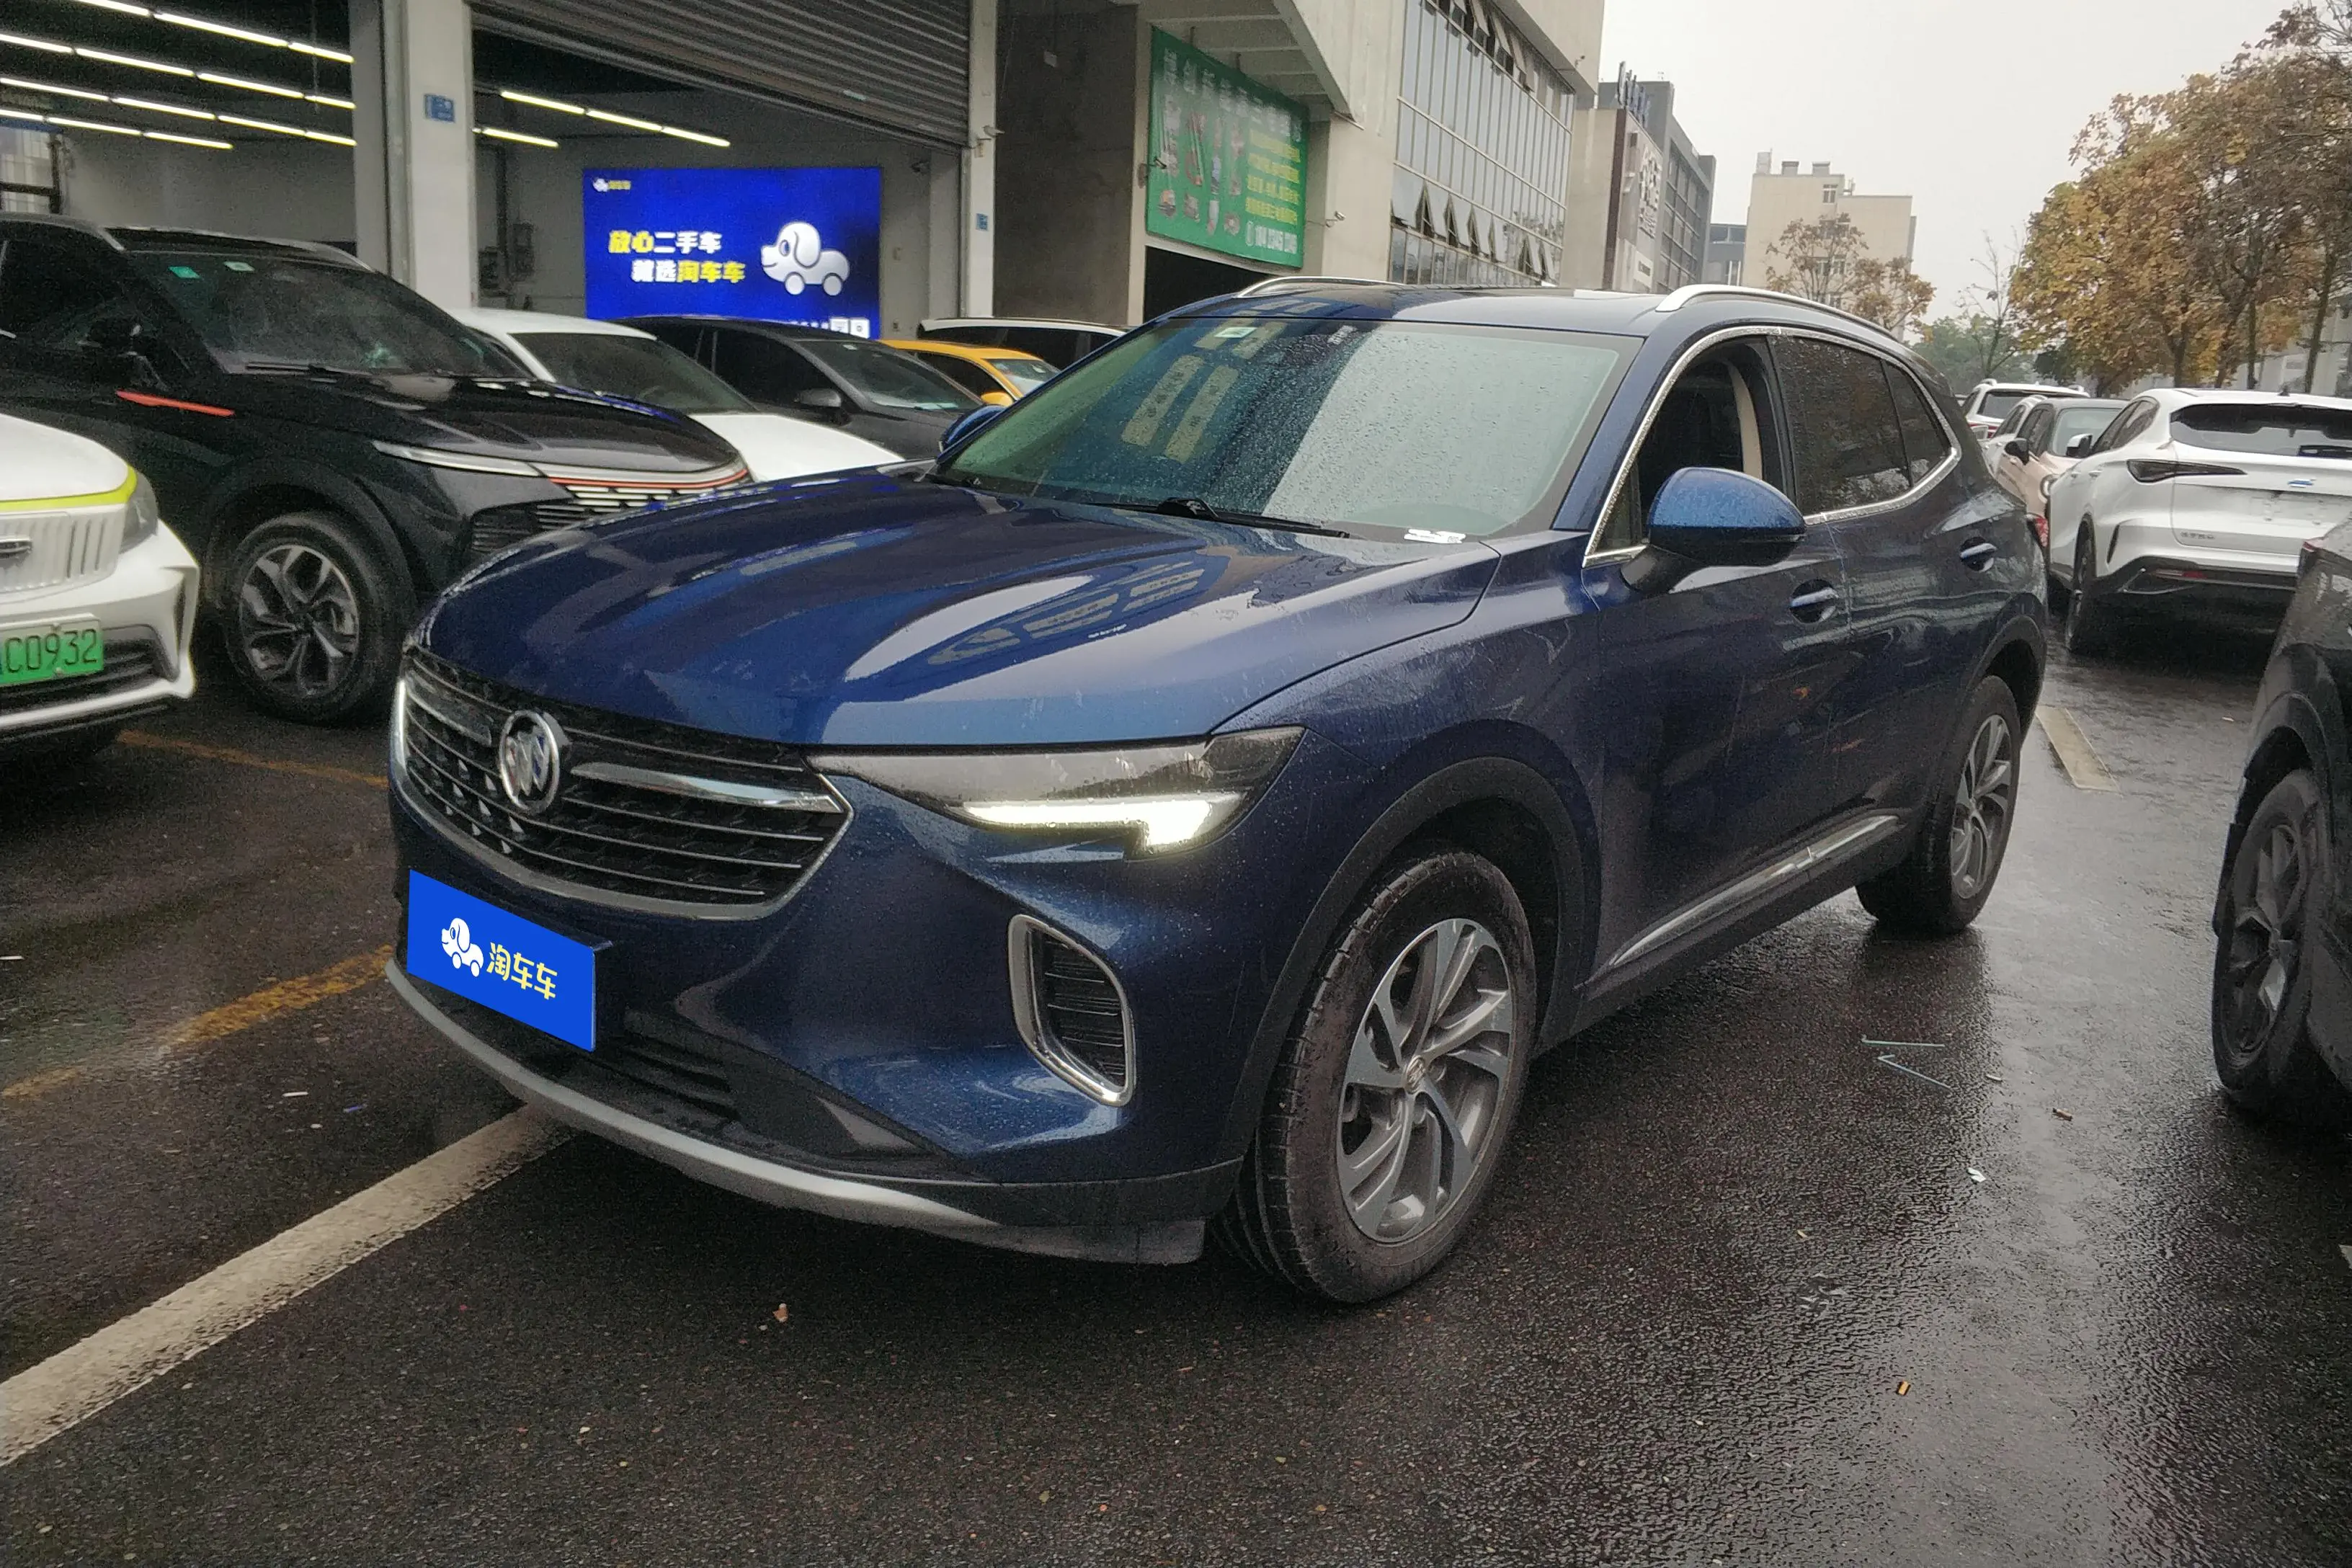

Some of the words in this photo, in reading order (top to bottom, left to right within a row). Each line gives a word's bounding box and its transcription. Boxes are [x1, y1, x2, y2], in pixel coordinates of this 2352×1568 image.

[608, 230, 722, 254] 放心二手车
[0, 628, 97, 674] C0932
